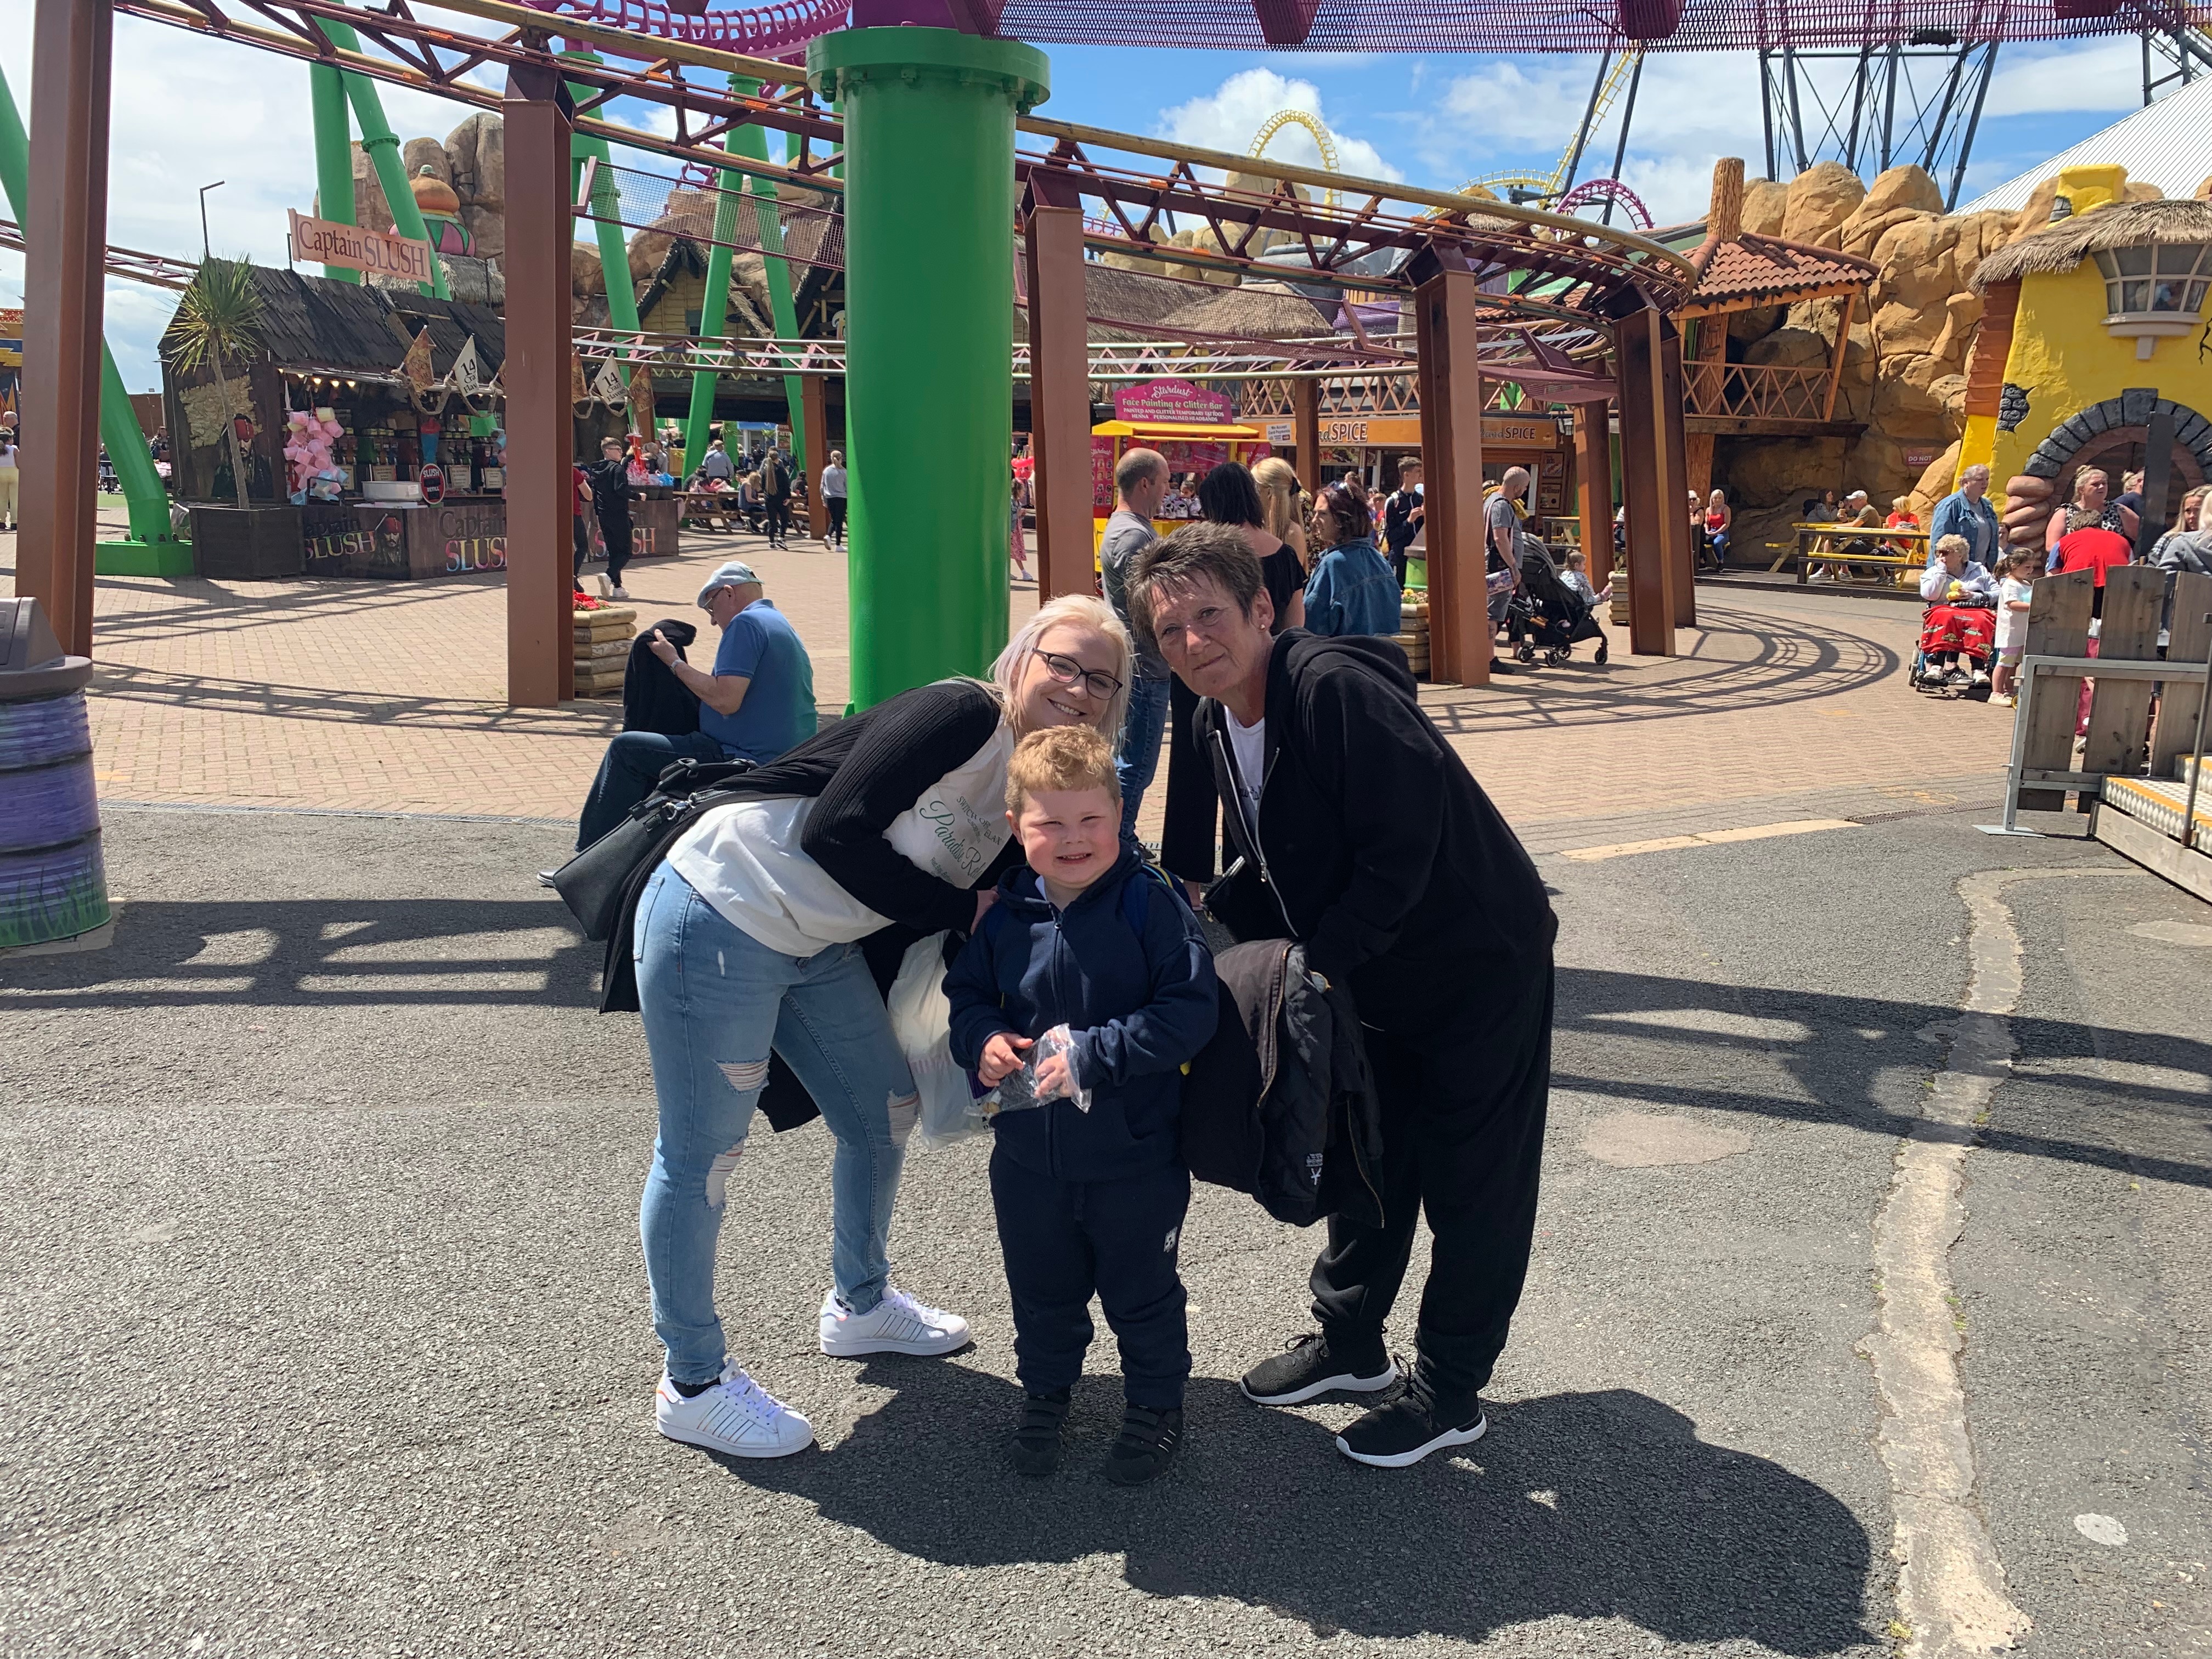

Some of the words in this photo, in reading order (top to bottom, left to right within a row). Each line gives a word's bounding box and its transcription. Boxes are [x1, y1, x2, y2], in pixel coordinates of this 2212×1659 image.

[299, 221, 363, 259] Captain
[364, 235, 426, 276] SLUSH
[461, 358, 476, 377] 14
[464, 375, 476, 383] Cra
[602, 371, 619, 386] 14
[464, 382, 477, 393] Flav
[1151, 385, 1193, 398] Stardust
[1141, 398, 1173, 410] Painting
[1183, 400, 1207, 409] Glitter
[423, 468, 439, 478] SLUSH
[594, 527, 657, 558] SSH
[445, 537, 507, 572] SLUS
[956, 795, 977, 820] SWITCH
[919, 800, 966, 862] Paradise
[984, 828, 1003, 845] ELAX
